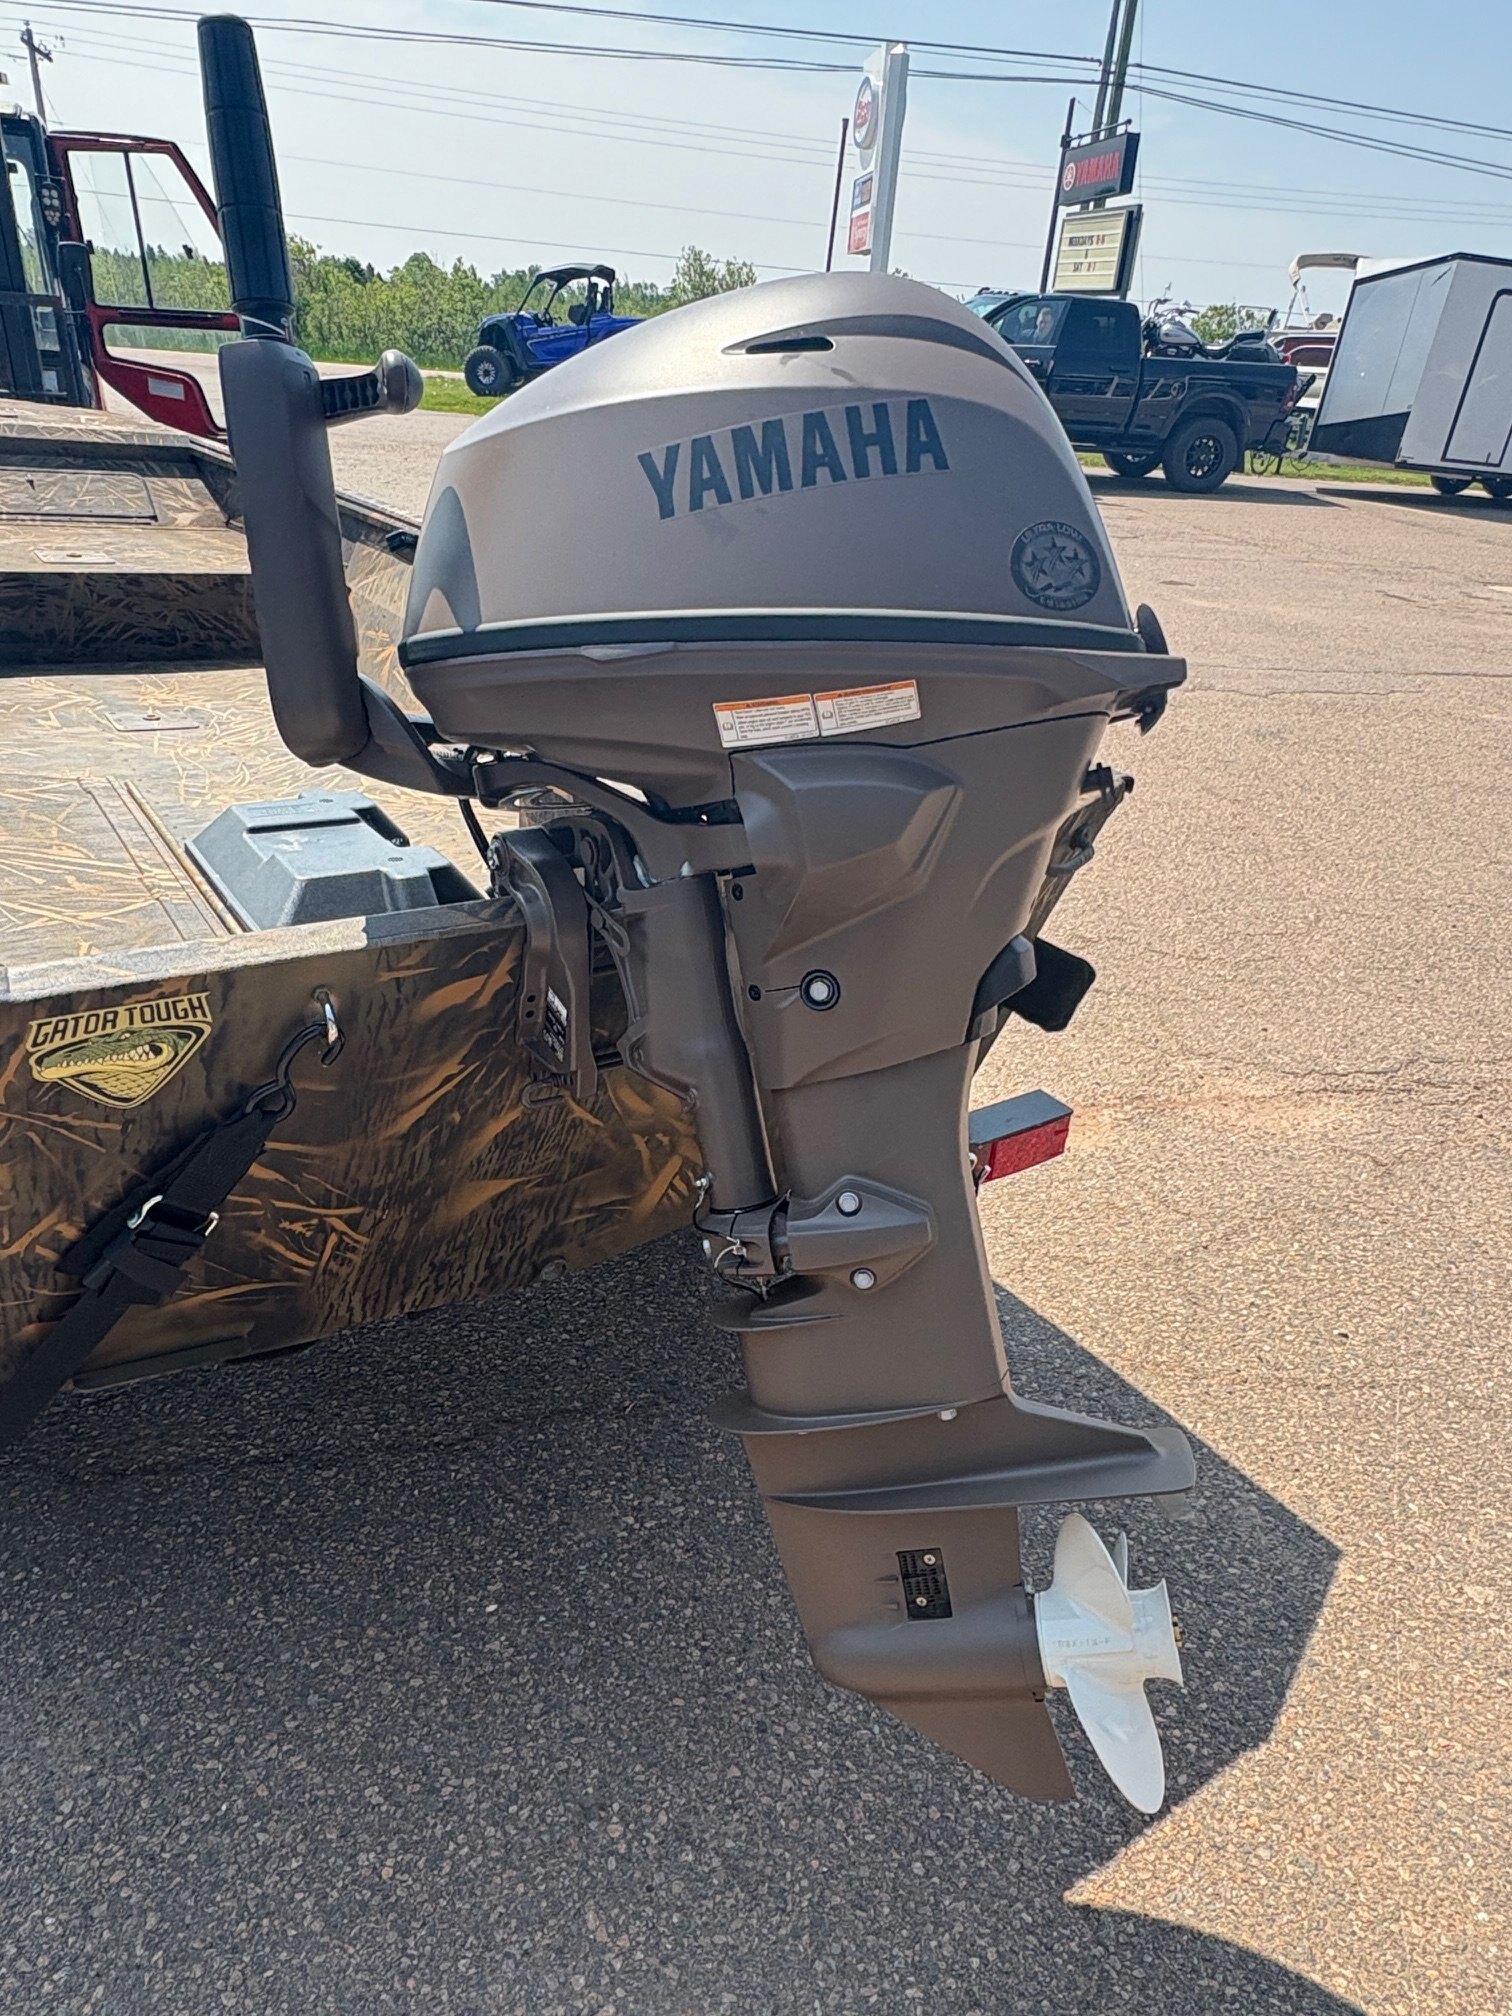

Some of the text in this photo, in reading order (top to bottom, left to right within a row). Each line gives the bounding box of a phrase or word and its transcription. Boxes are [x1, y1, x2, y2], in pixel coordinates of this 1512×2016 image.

[1074, 151, 1120, 186] YAMAHA
[637, 398, 950, 520] YAMAHA
[31, 996, 208, 1048] GATOR TOUGH
